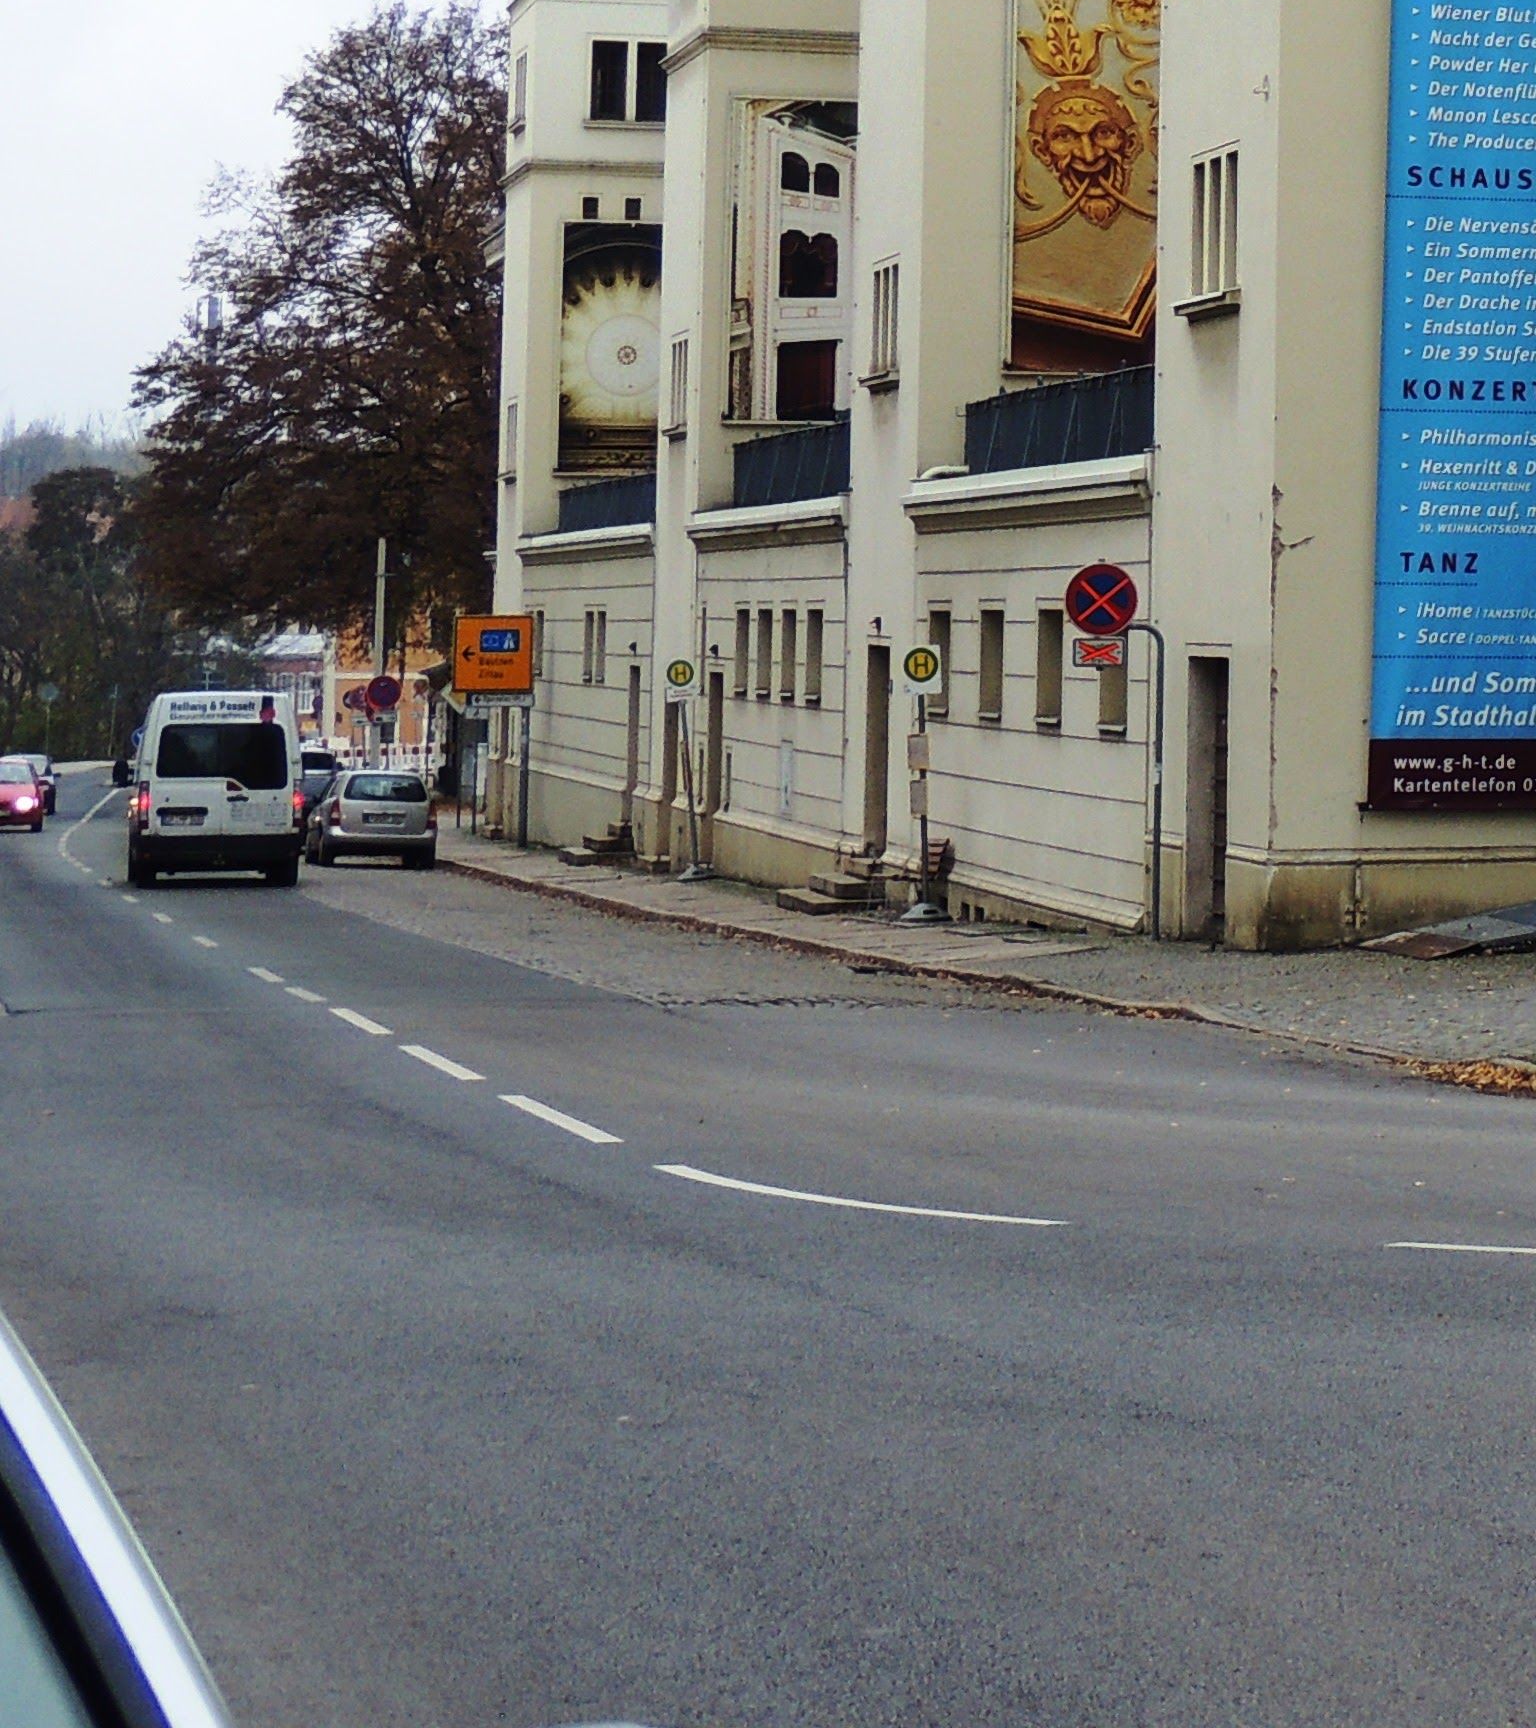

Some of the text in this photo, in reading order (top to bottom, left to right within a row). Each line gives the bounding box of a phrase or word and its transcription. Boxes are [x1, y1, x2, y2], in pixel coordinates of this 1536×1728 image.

[1430, 4, 1491, 22] Wiener
[1495, 6, 1531, 23] Blut
[1429, 29, 1479, 46] Nacht
[1484, 32, 1513, 48] der
[1429, 55, 1494, 72] Powder
[1498, 58, 1529, 74] Her
[1428, 80, 1459, 97] Der
[1427, 106, 1486, 123] Manon
[1427, 132, 1458, 148] The
[1424, 216, 1454, 233] Die
[1424, 241, 1451, 258] Ein
[1423, 267, 1455, 284] Der
[1423, 293, 1454, 310] Der
[1459, 294, 1521, 311] Drache
[1422, 318, 1517, 336] Endstation
[1421, 344, 1451, 361] Die
[1455, 345, 1479, 361] 39
[1418, 458, 1502, 476] Hexenritt
[1506, 460, 1518, 476] &
[1418, 480, 1532, 492] JUNGE KONZERTREIHE
[1418, 500, 1481, 518] Brenne
[1486, 501, 1520, 521] auf,
[1417, 523, 1434, 533] 39.
[1400, 552, 1480, 574] TANZ
[1416, 601, 1473, 619] iHome
[1416, 628, 1467, 645] Sacre
[674, 665, 687, 681] H
[914, 655, 929, 675] H
[1405, 671, 1477, 694] ...und
[1396, 704, 1426, 727] im
[1393, 754, 1517, 773] www.g-h-t.de
[1393, 777, 1516, 793] Kartentelefon
